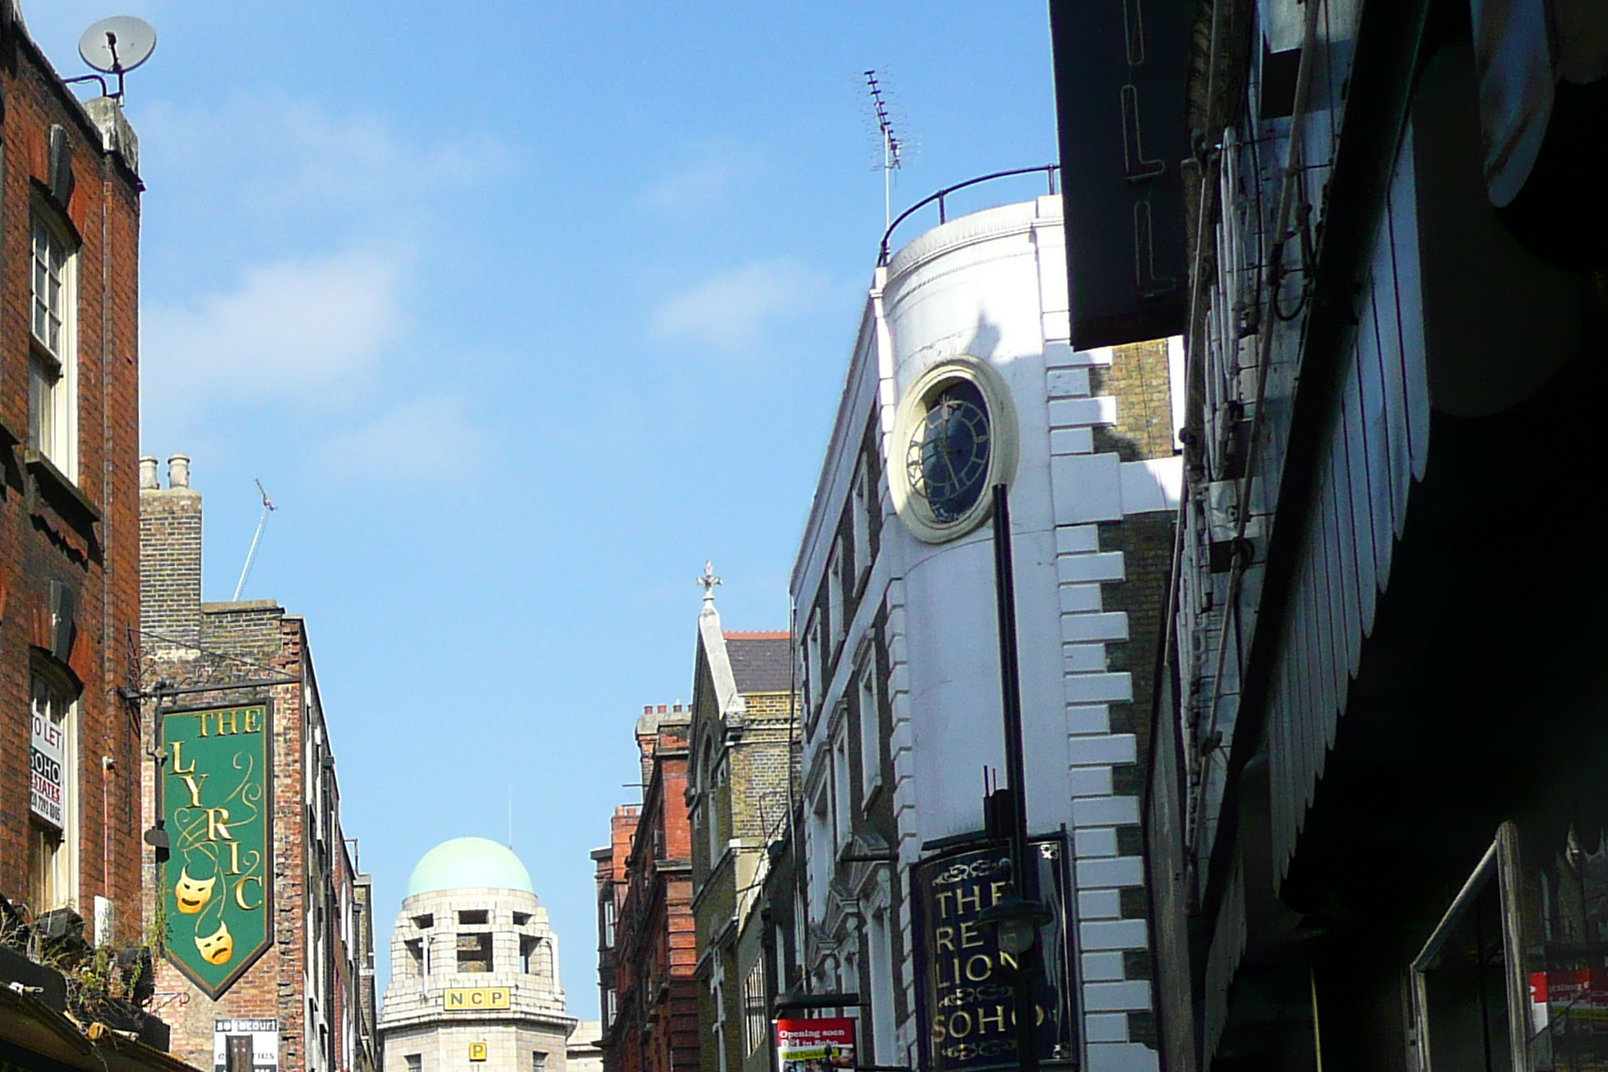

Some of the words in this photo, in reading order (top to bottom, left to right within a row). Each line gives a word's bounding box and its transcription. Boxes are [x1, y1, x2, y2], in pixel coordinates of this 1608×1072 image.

[30, 714, 41, 736] TO
[44, 722, 61, 750] LET
[194, 709, 261, 738] THE
[169, 740, 262, 910] LYRIC
[935, 881, 1007, 918] THE
[935, 921, 985, 954] RE
[449, 992, 503, 1005] NCP
[779, 1029, 820, 1039] Opening
[822, 1029, 845, 1038] soon
